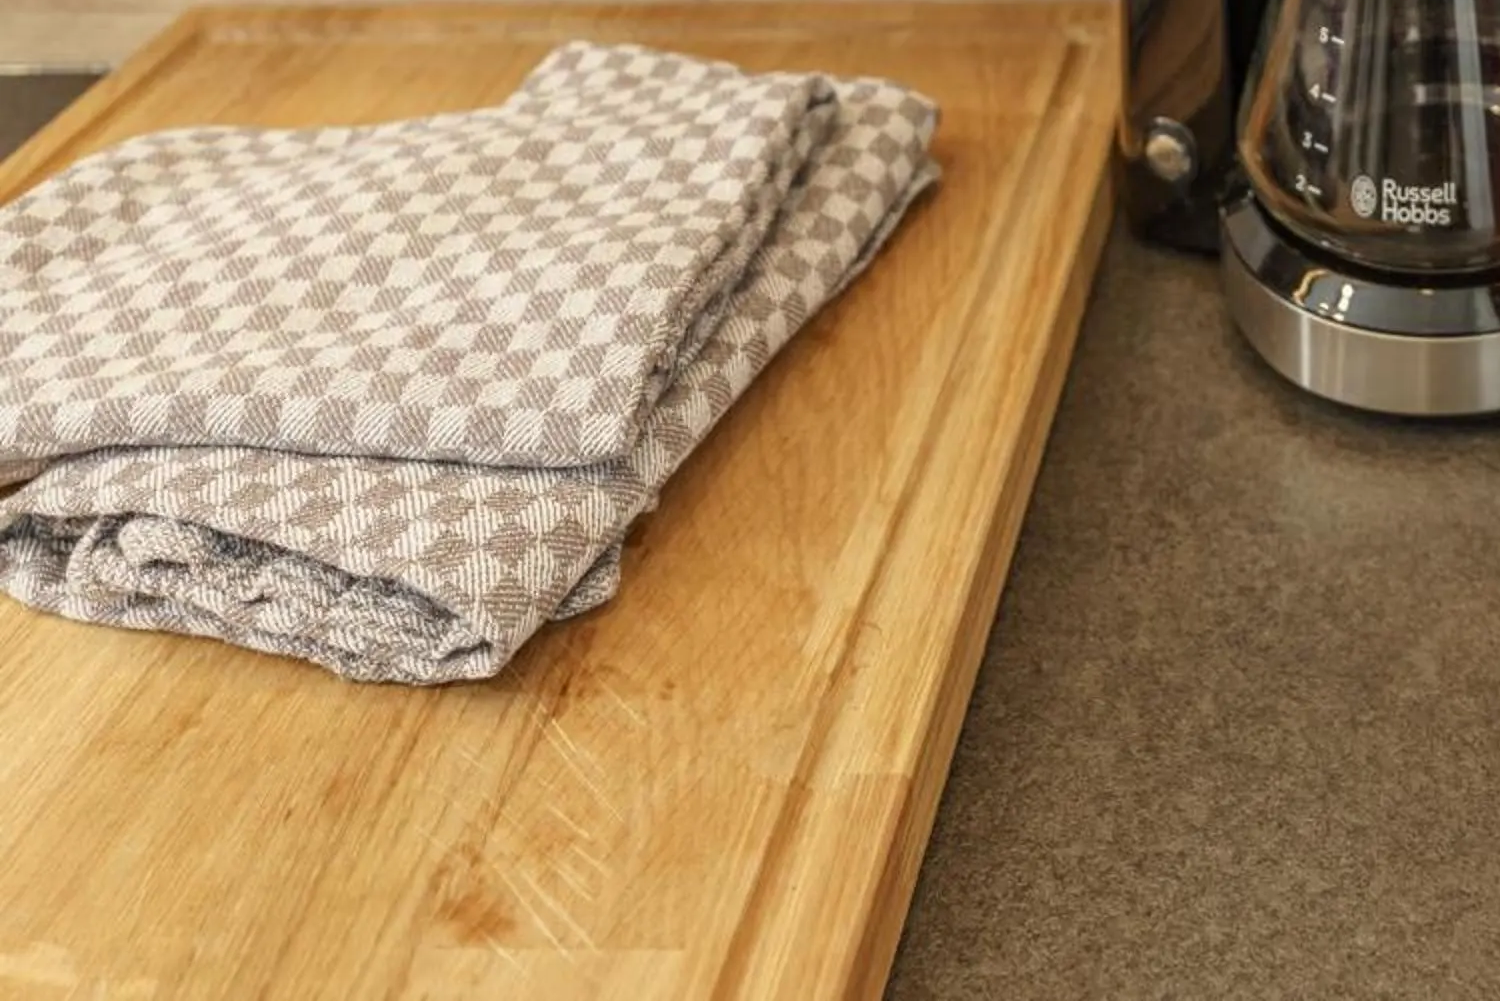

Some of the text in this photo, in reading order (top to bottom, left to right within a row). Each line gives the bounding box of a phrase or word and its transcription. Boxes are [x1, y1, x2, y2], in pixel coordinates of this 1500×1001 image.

[1308, 82, 1321, 99] 4
[1294, 173, 1307, 192] 2
[1381, 177, 1457, 205] Russell
[1381, 199, 1452, 227] Hobbs
